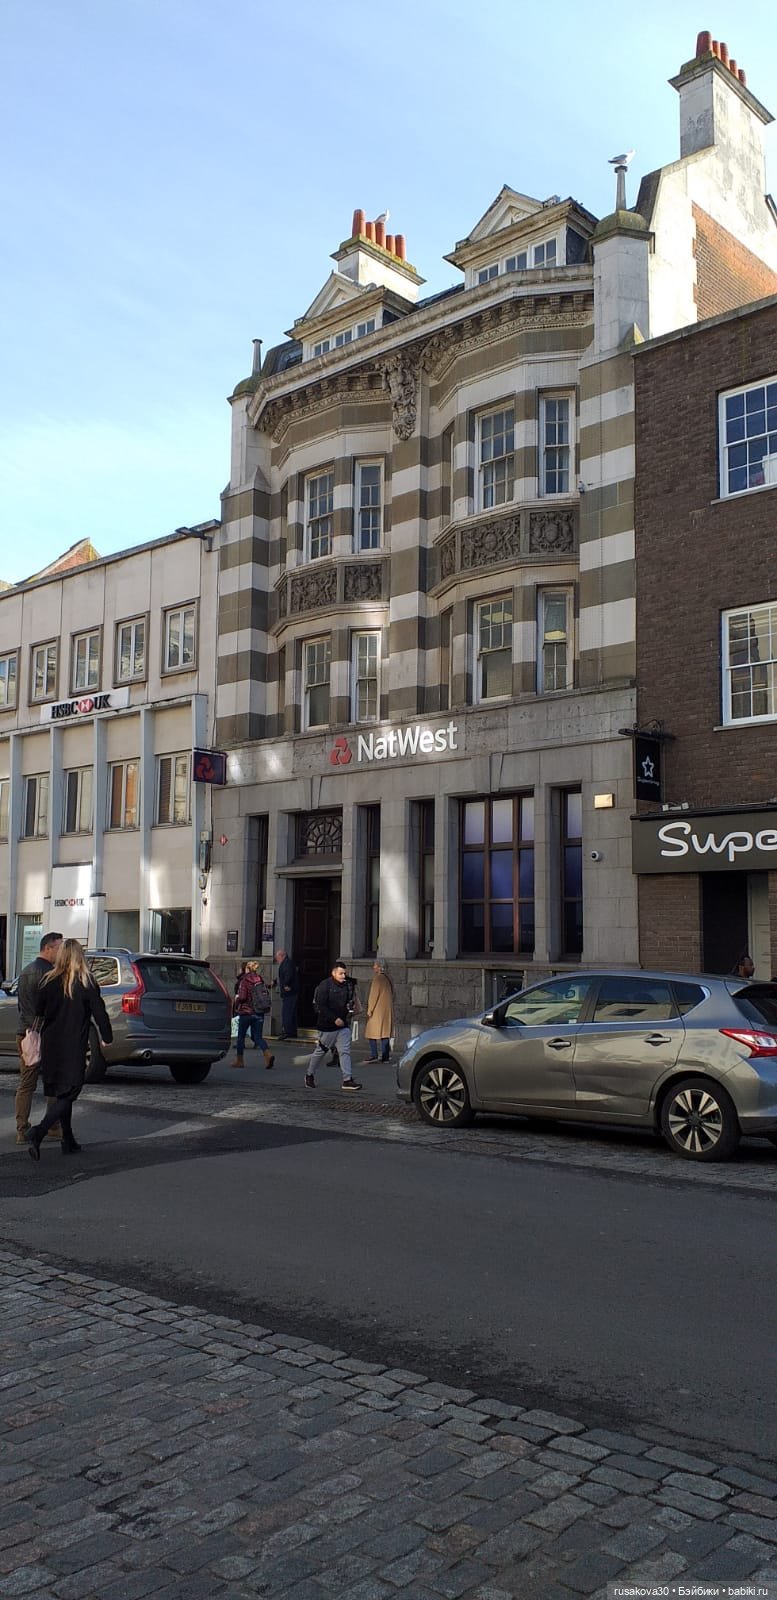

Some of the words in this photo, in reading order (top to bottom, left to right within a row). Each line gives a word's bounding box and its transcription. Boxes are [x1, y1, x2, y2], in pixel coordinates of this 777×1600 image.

[51, 701, 79, 719] HSBC
[94, 694, 112, 709] UK
[357, 720, 458, 762] NatWest
